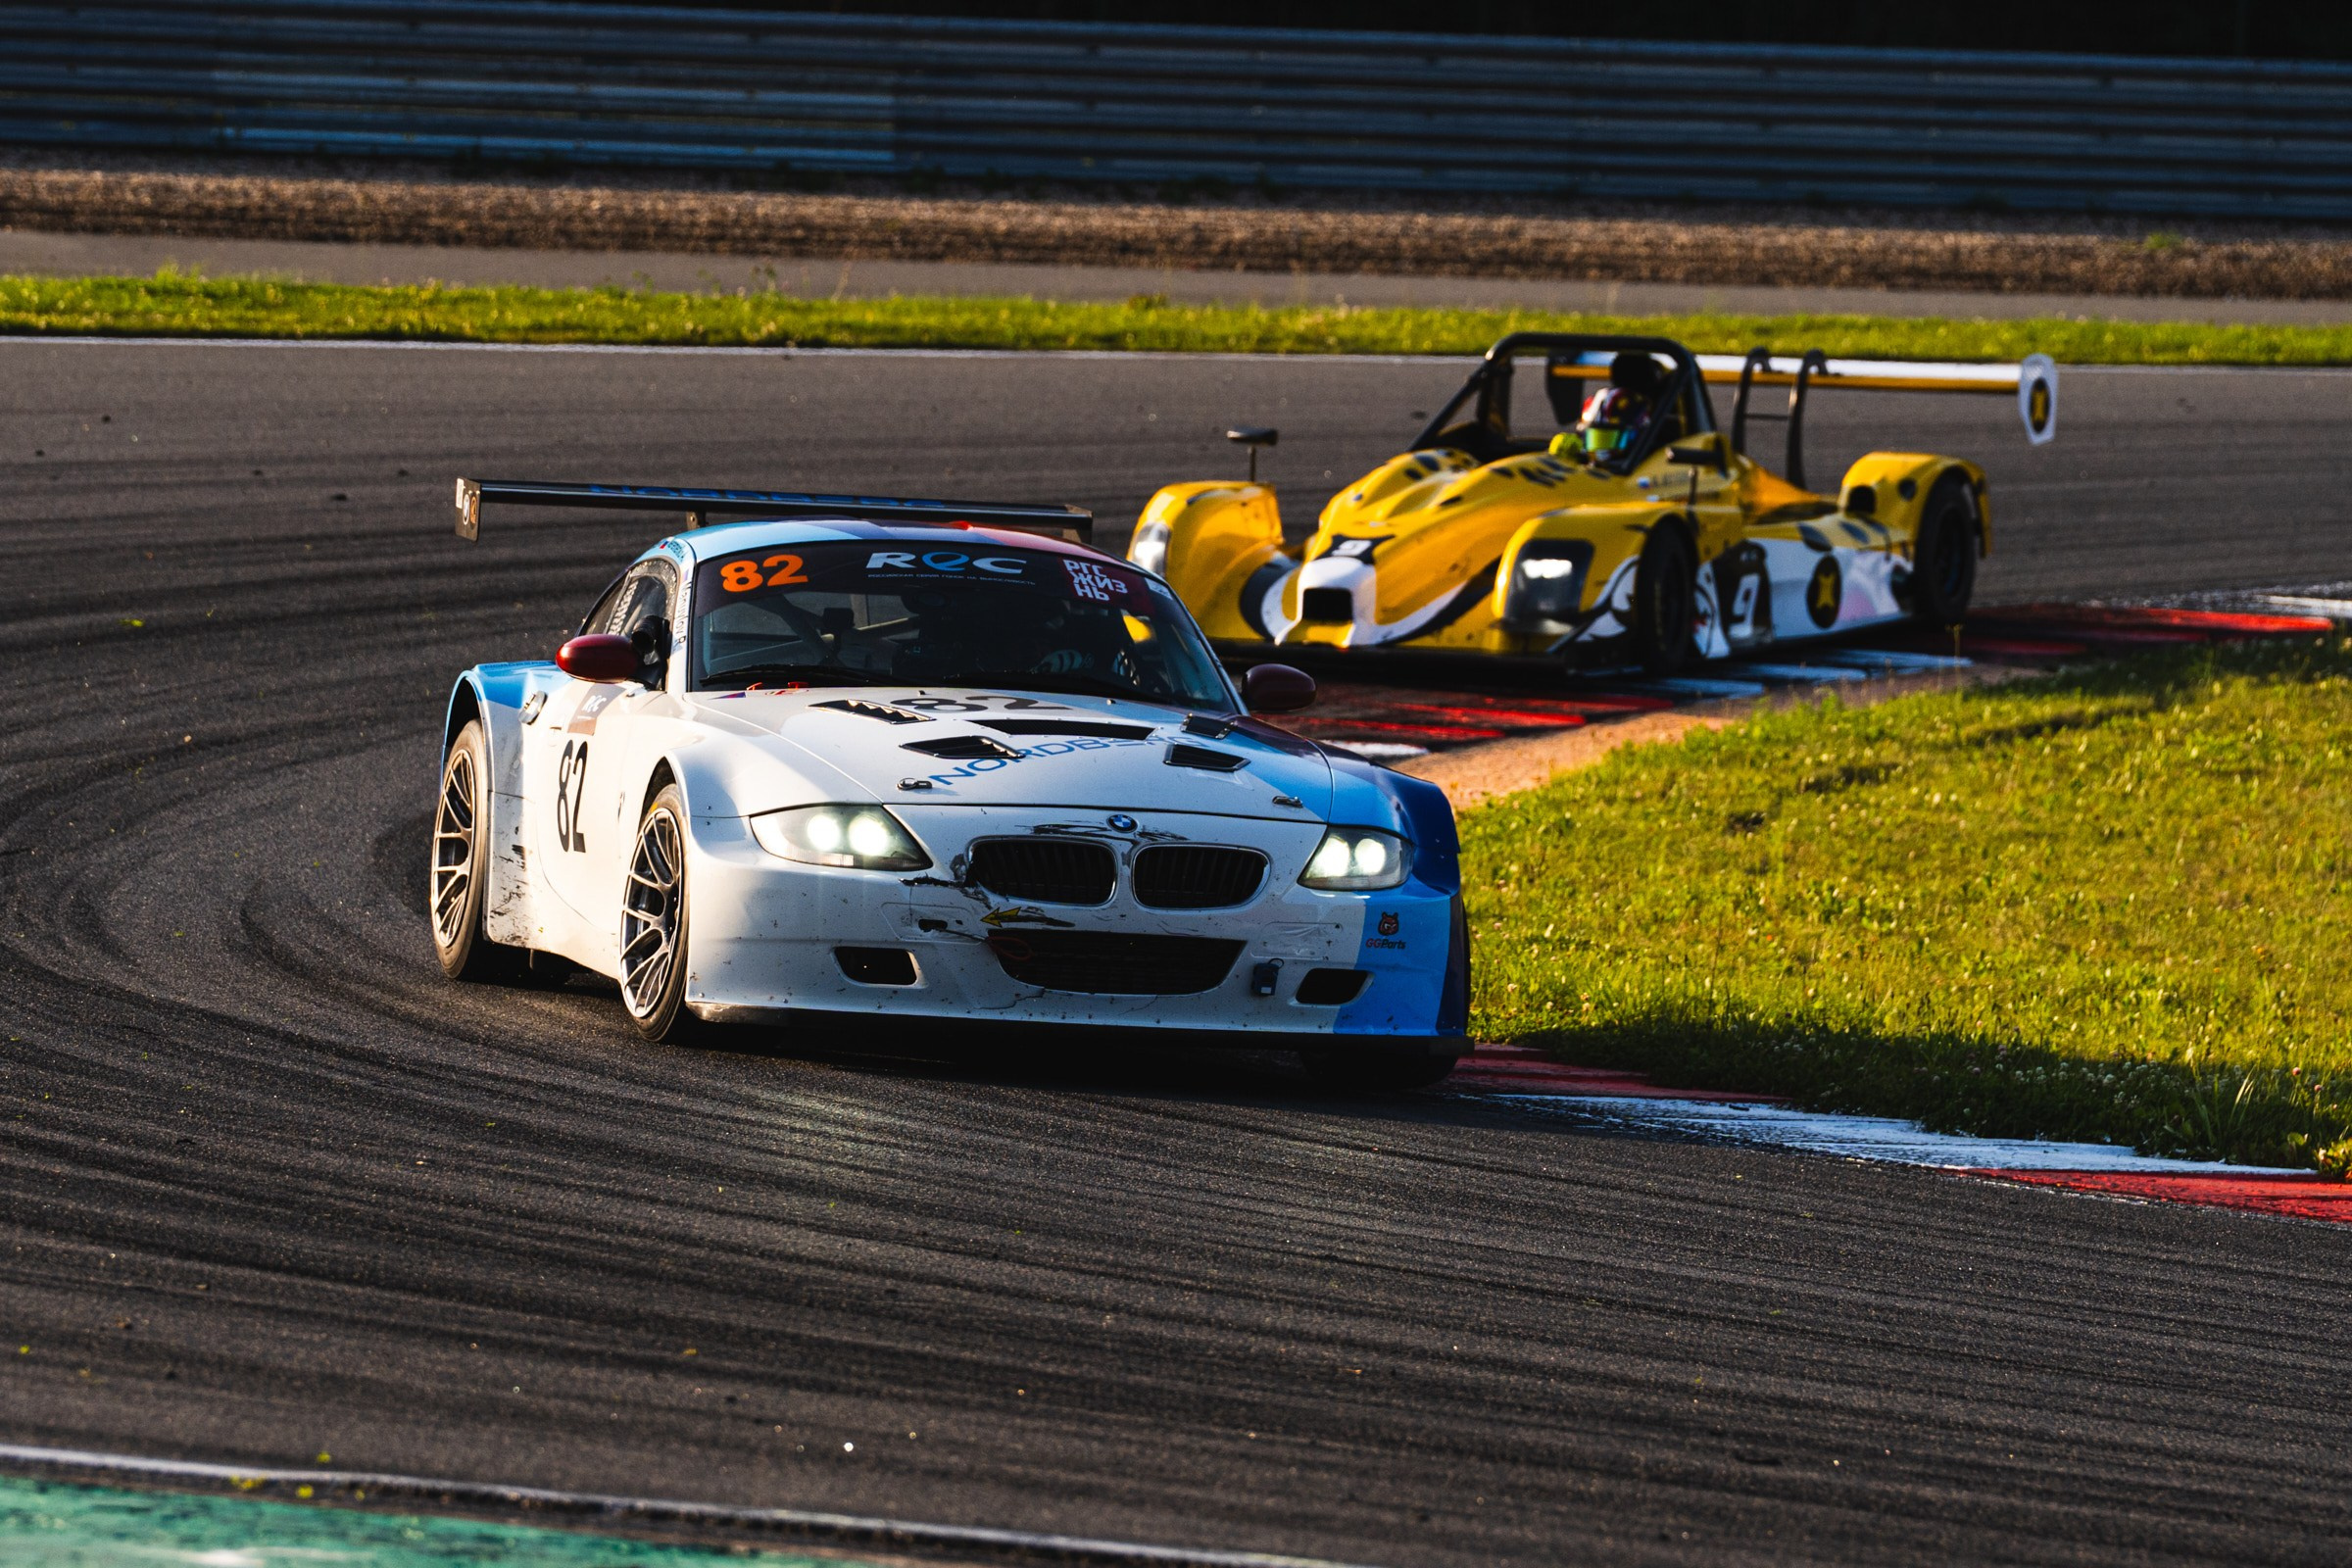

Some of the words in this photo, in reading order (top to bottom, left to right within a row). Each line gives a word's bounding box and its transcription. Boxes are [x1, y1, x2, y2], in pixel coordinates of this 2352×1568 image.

[719, 554, 808, 592] 82
[1062, 560, 1107, 577] РГС
[1073, 583, 1110, 601] НЬ
[1727, 573, 1760, 638] 9
[890, 696, 1073, 712] 82
[557, 739, 589, 854] 82
[1365, 937, 1407, 950] GGParts
